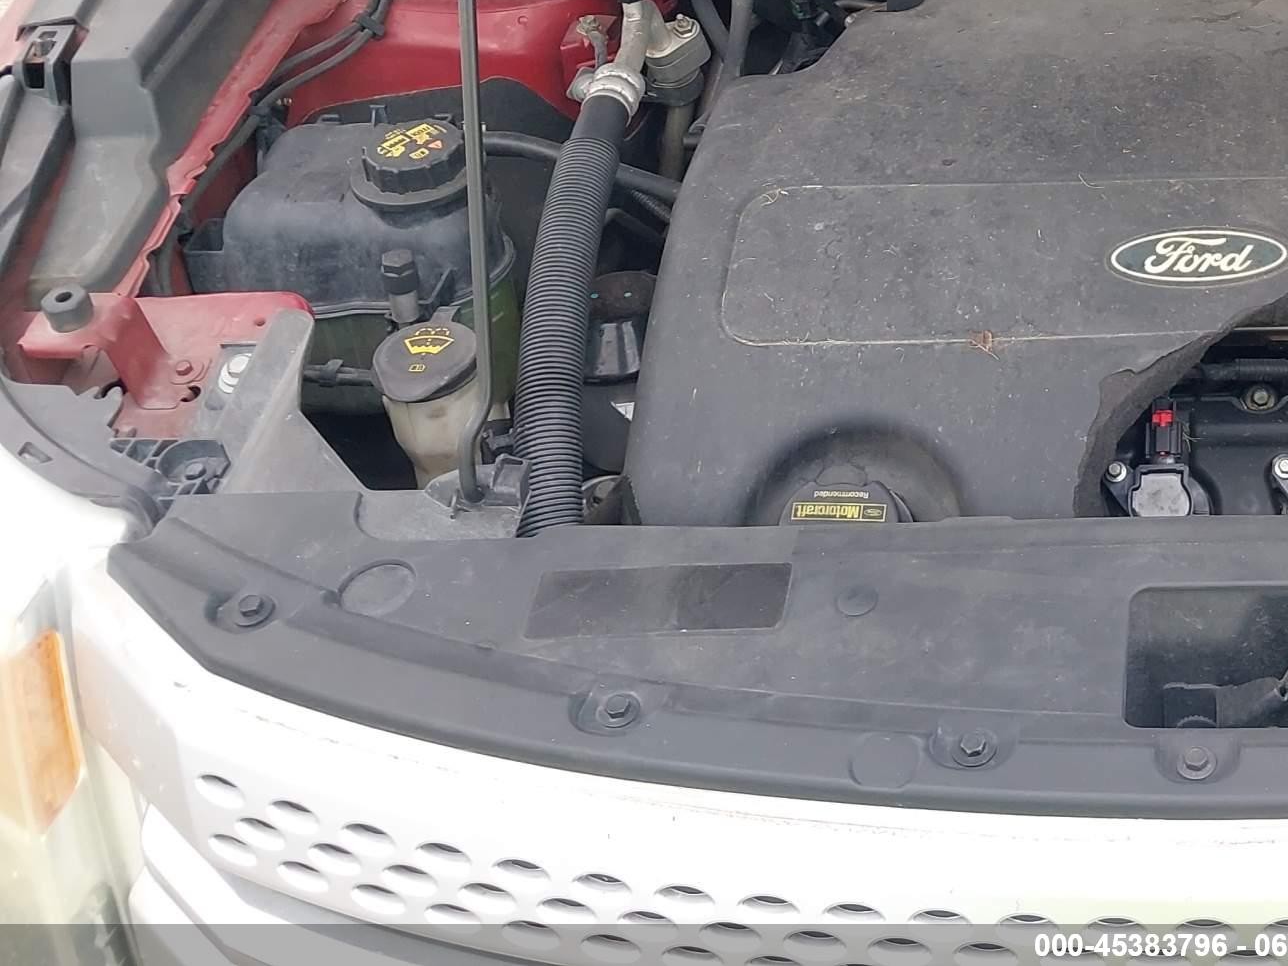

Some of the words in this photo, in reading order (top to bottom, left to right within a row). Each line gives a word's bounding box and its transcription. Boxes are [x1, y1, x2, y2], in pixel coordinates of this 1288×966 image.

[1143, 236, 1255, 274] Ford
[813, 490, 870, 499] Recommended
[794, 504, 860, 518] Motorcraft
